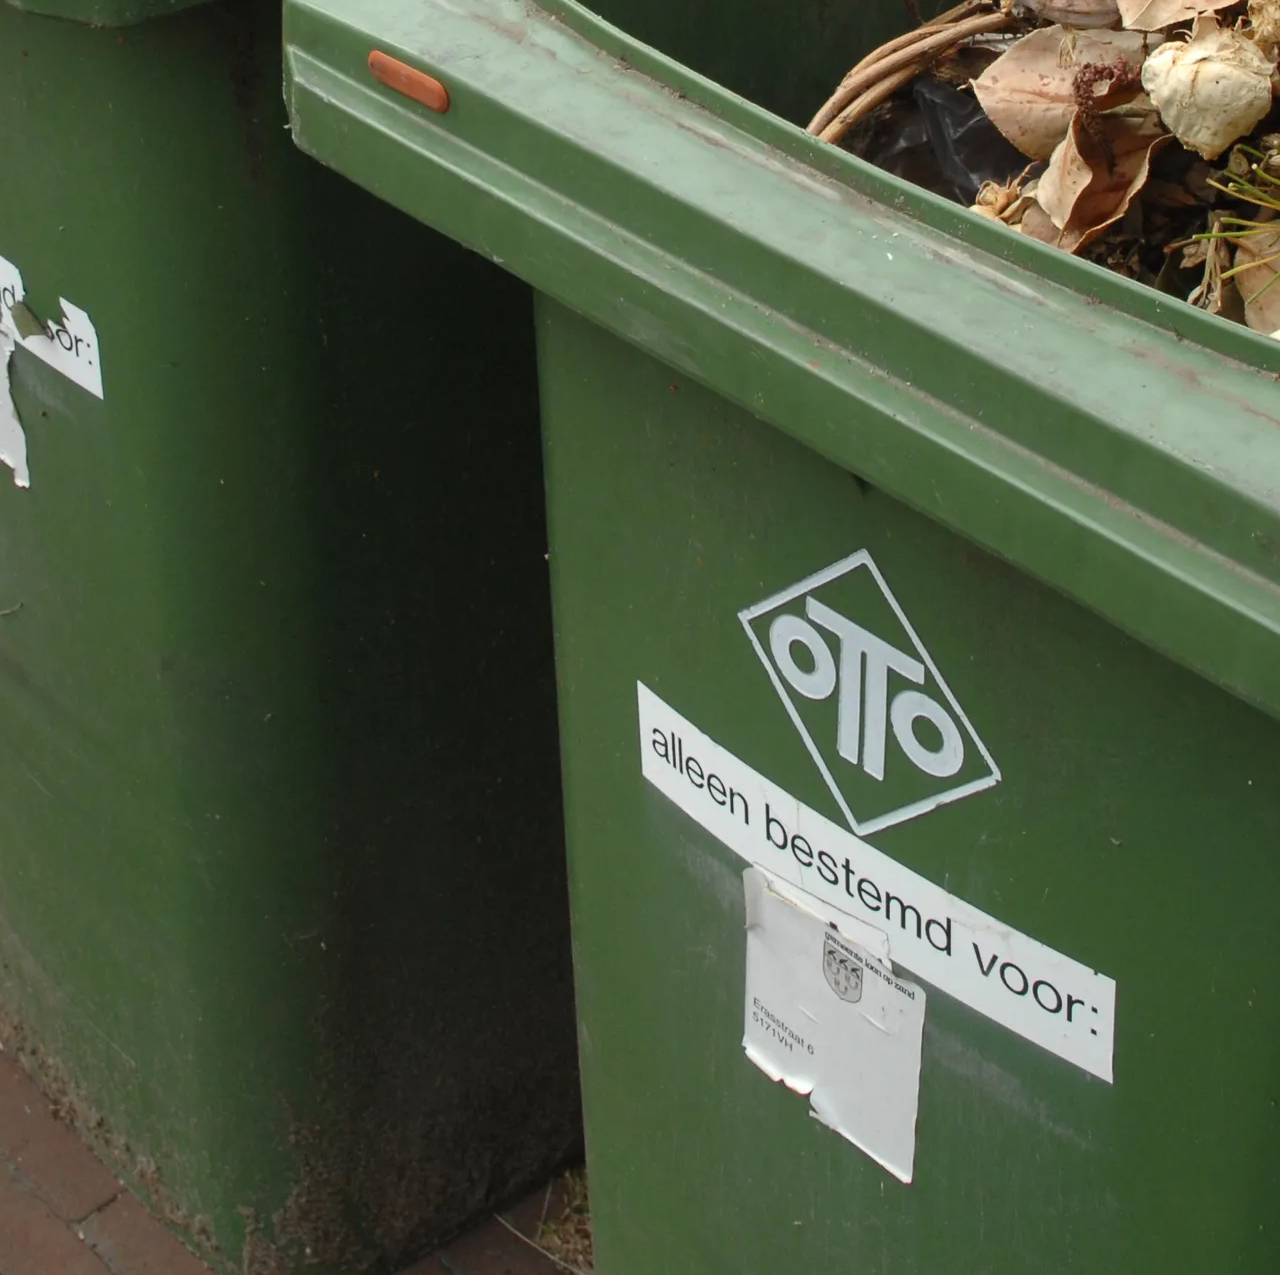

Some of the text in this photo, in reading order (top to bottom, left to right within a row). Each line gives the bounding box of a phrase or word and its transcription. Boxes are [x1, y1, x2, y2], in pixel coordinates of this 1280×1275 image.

[769, 594, 964, 782] OTTO
[651, 726, 1099, 1036] alleen bestemd voor:
[824, 931, 916, 1001] gemeente loon op zand
